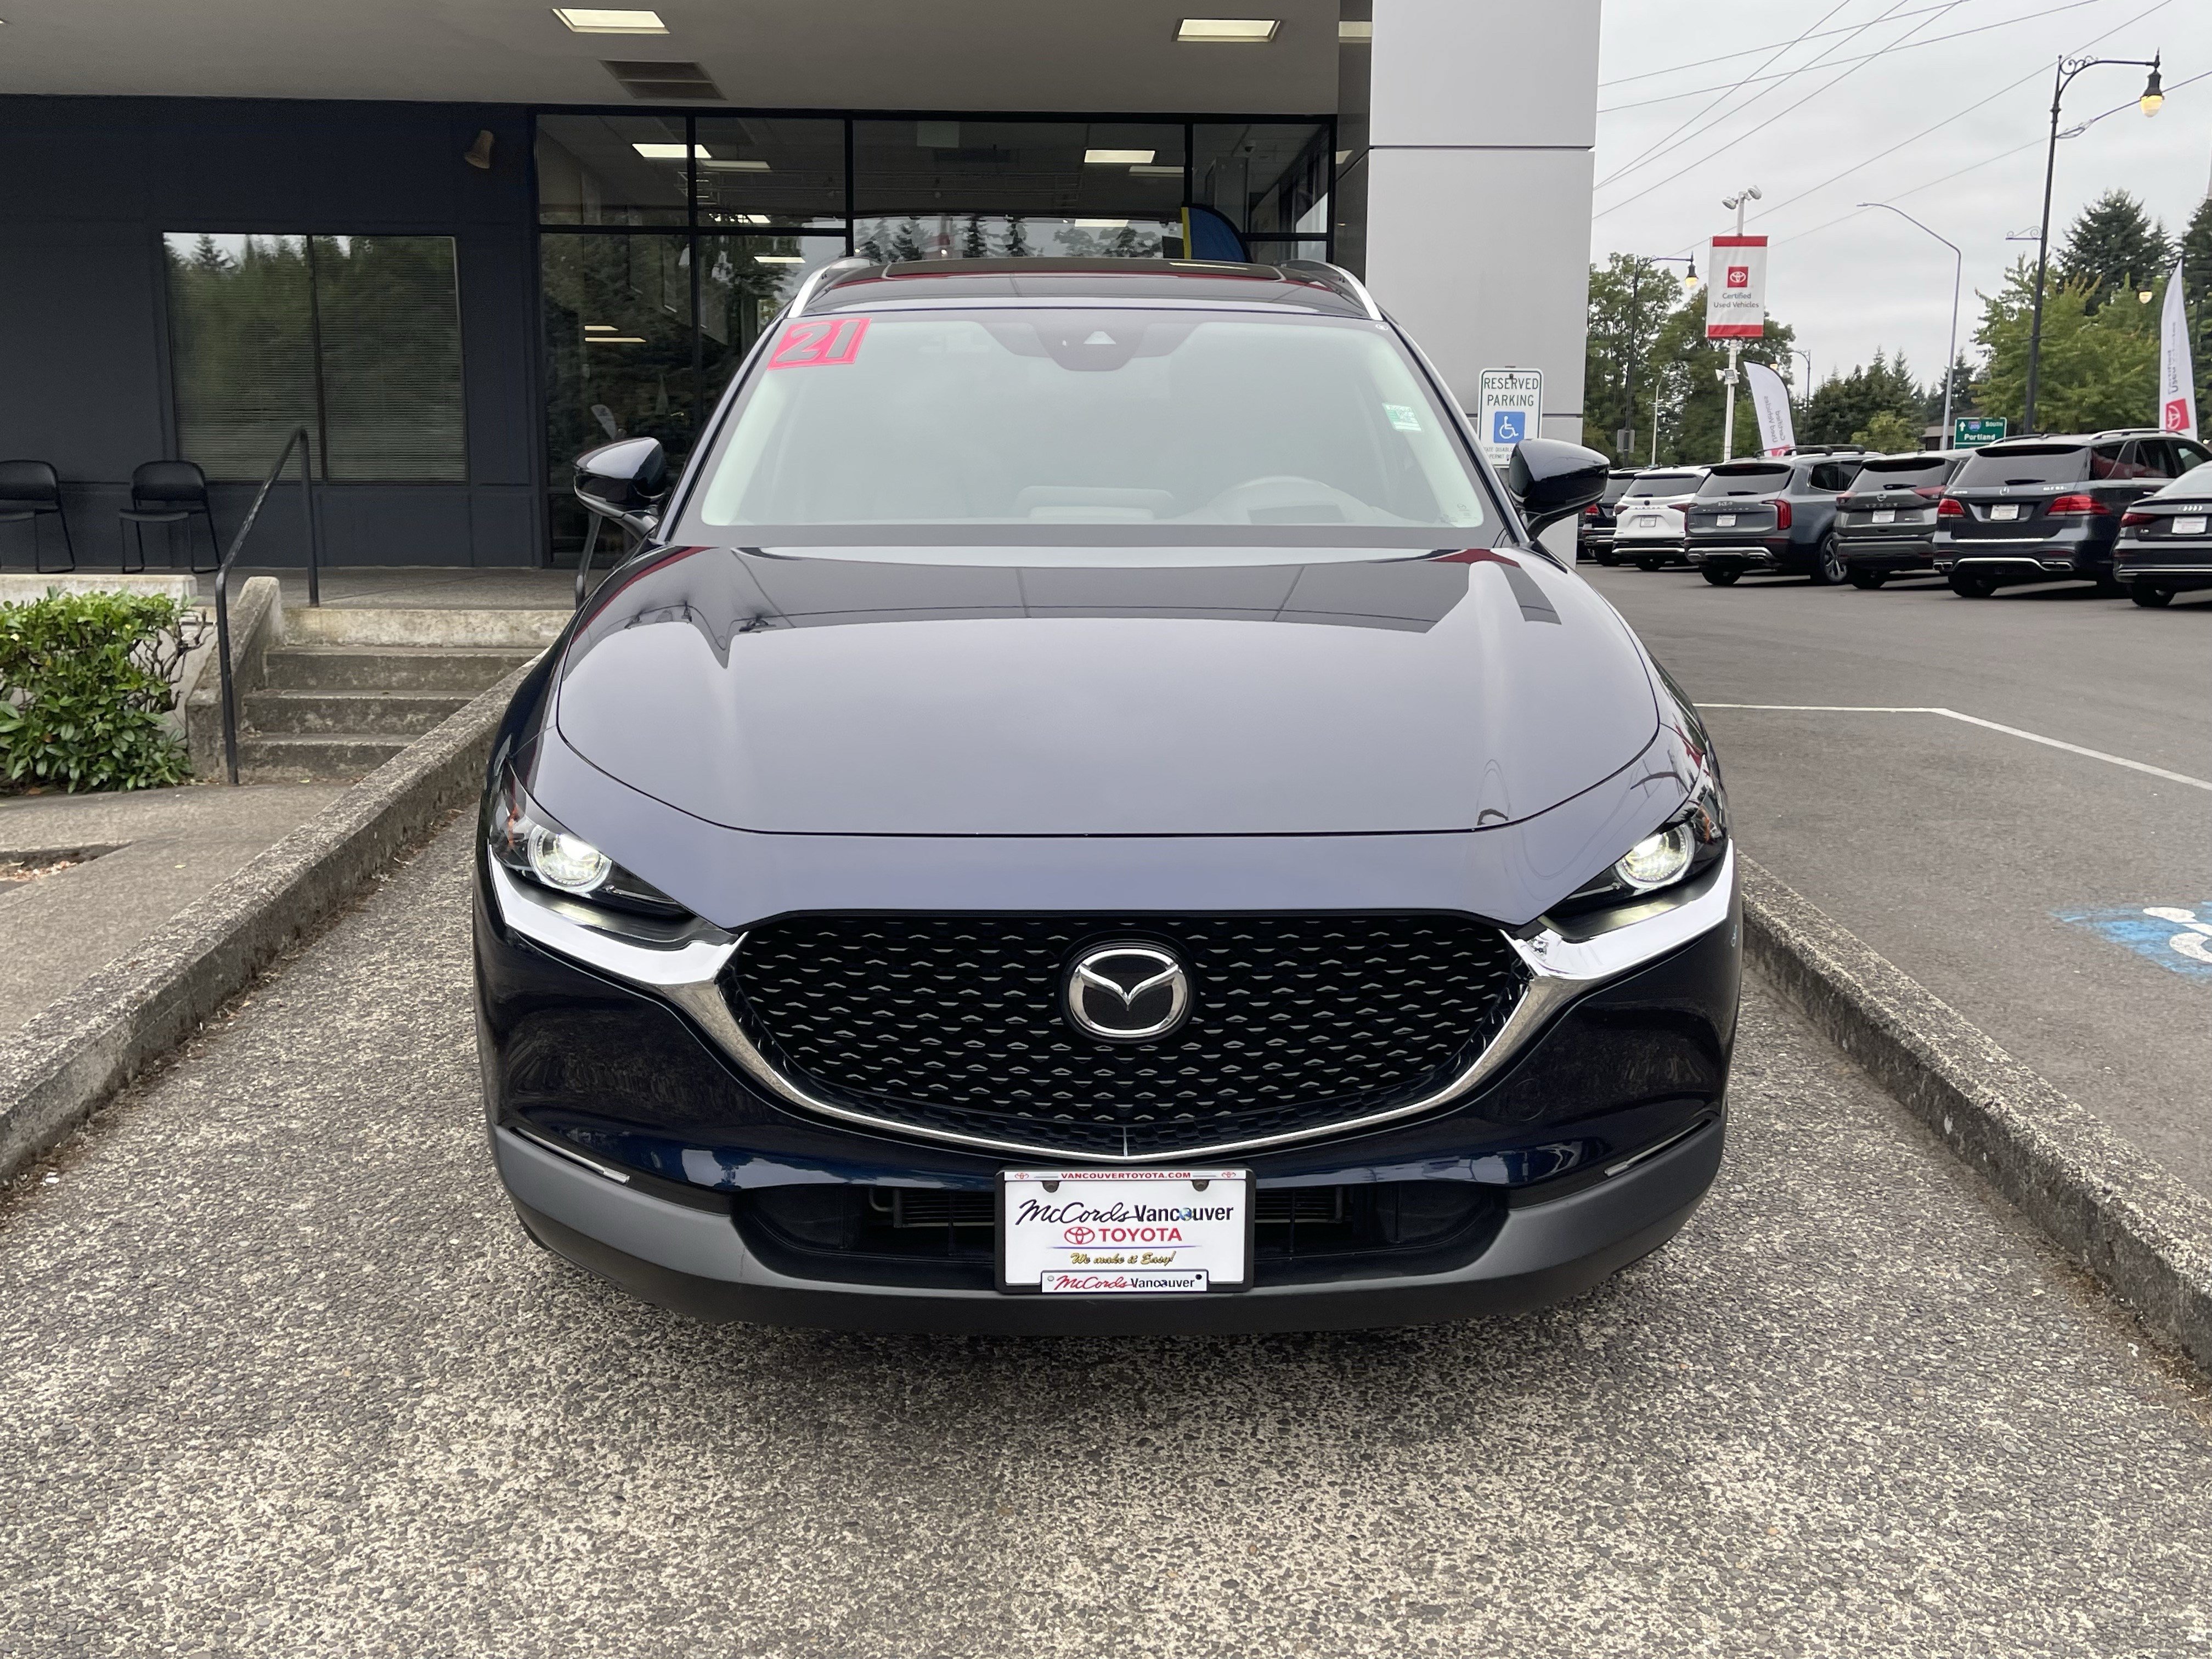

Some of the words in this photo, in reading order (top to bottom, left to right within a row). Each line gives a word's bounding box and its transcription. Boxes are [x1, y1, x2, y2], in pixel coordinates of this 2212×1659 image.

[775, 321, 861, 363] 21
[1483, 377, 1538, 390] RESERVED
[1487, 394, 1534, 406] PARKING
[1098, 1228, 1182, 1242] TOYOTA
[1070, 1252, 1091, 1264] We
[1093, 1253, 1125, 1264] make
[1127, 1255, 1138, 1264] it
[1141, 1251, 1176, 1266] Easy!
